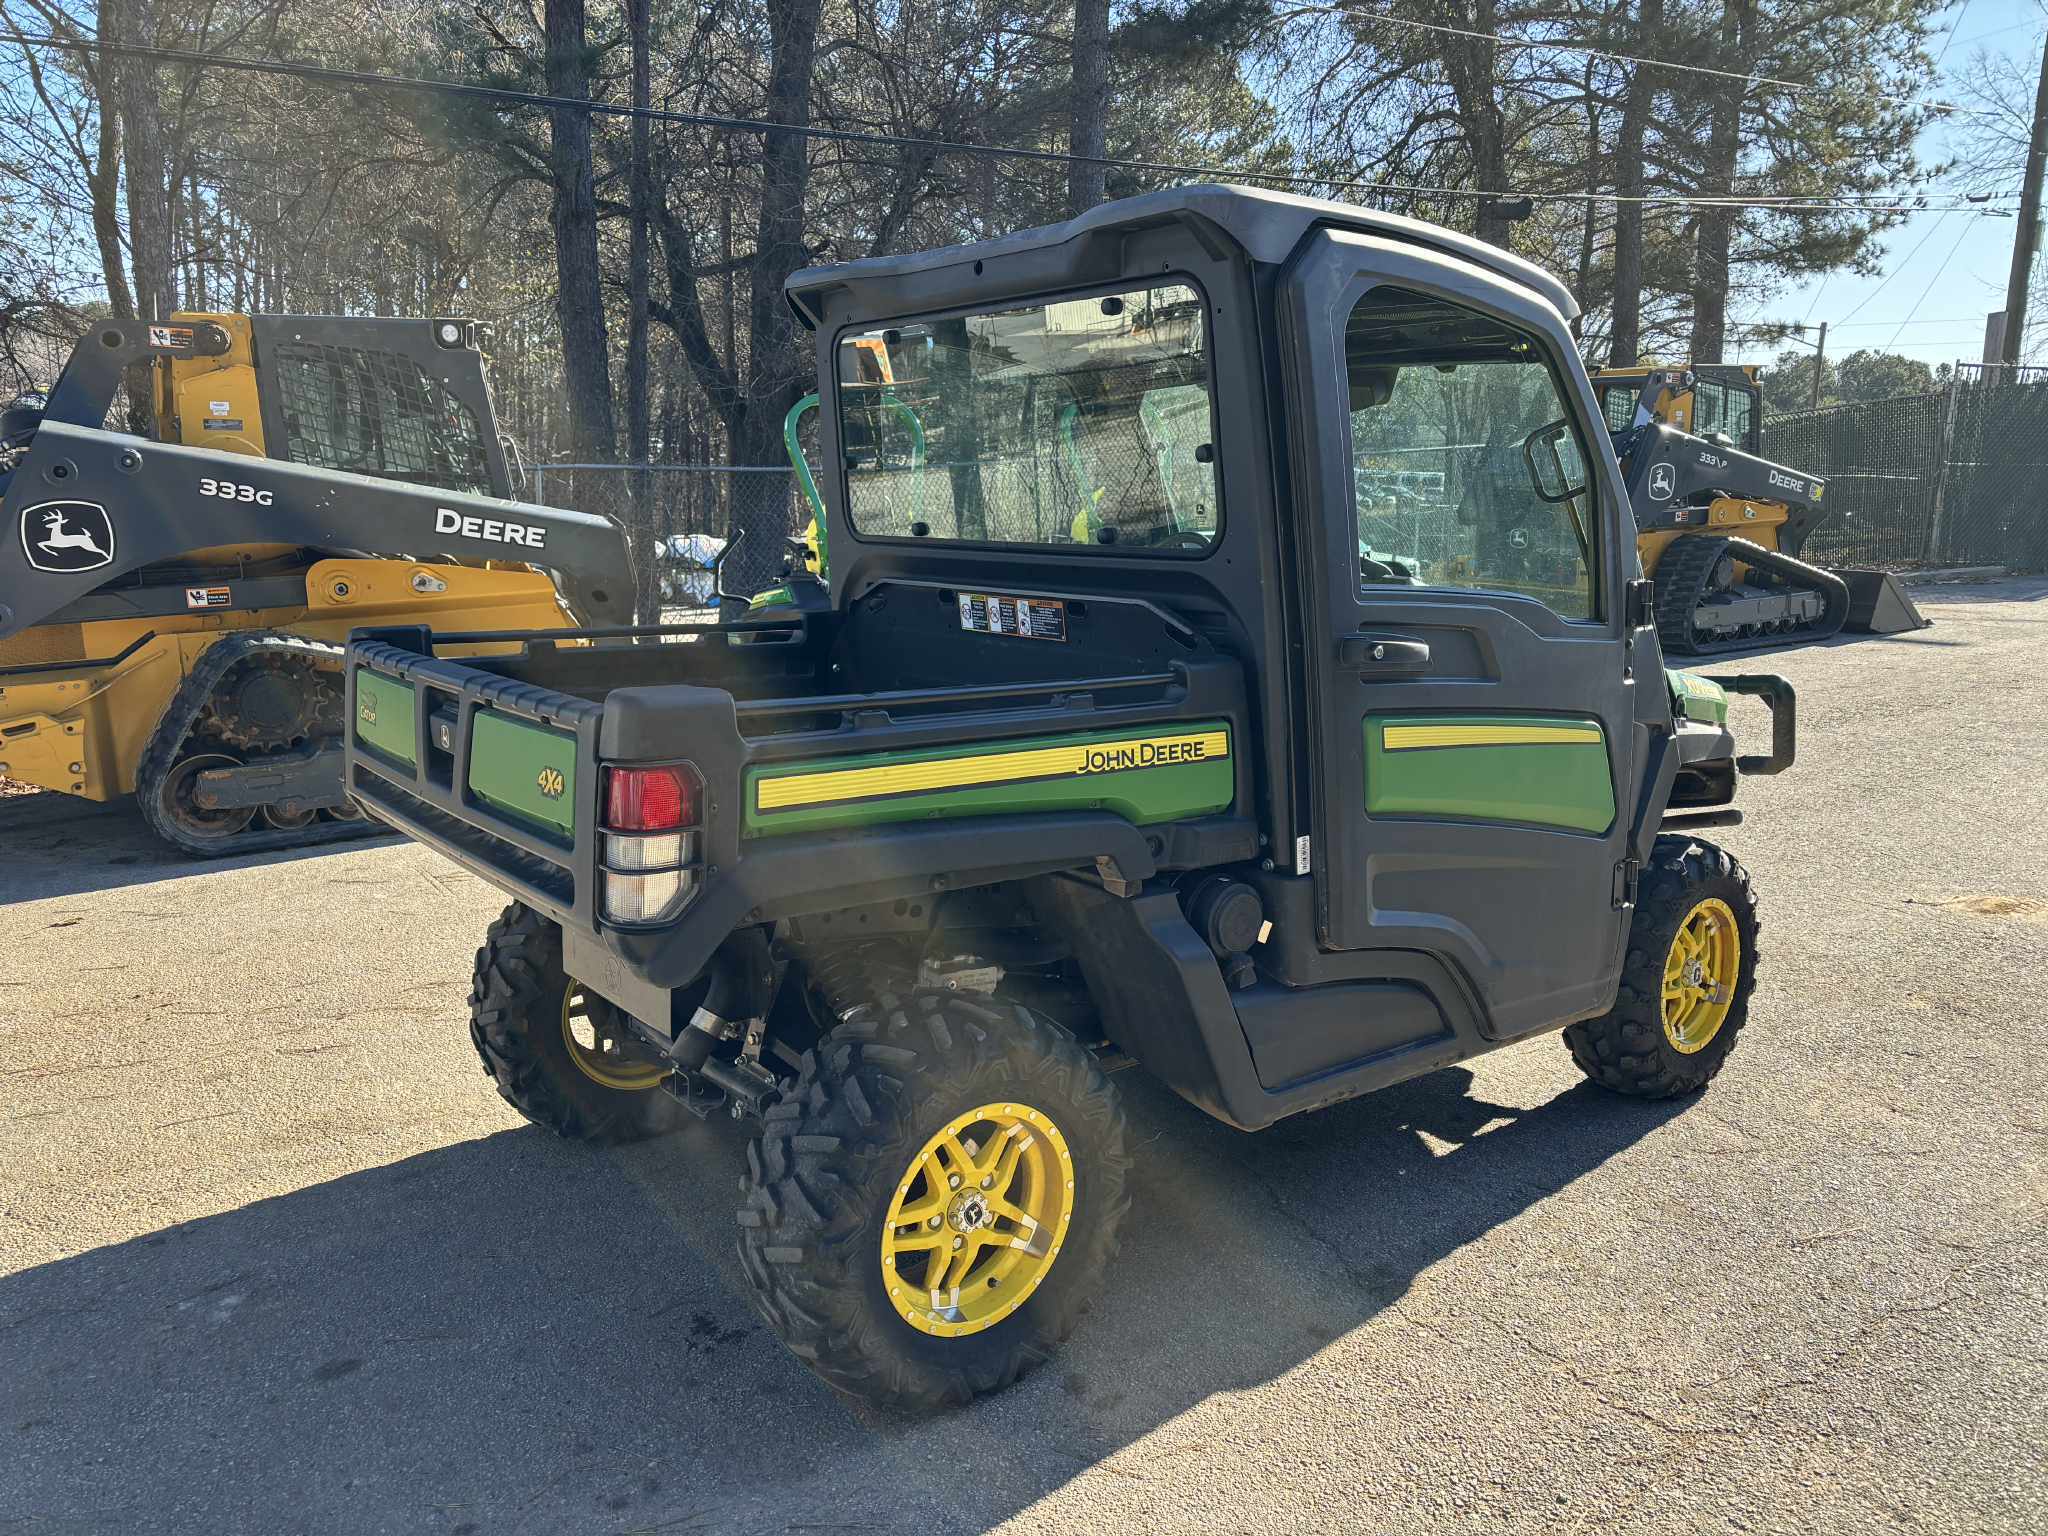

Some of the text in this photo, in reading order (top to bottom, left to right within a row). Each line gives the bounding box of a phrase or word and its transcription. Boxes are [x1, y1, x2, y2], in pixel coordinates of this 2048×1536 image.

[199, 478, 273, 506] 333G
[1768, 469, 1805, 493] DEERE
[435, 507, 547, 548] DEERE
[1078, 741, 1205, 772] JOHN DEERE
